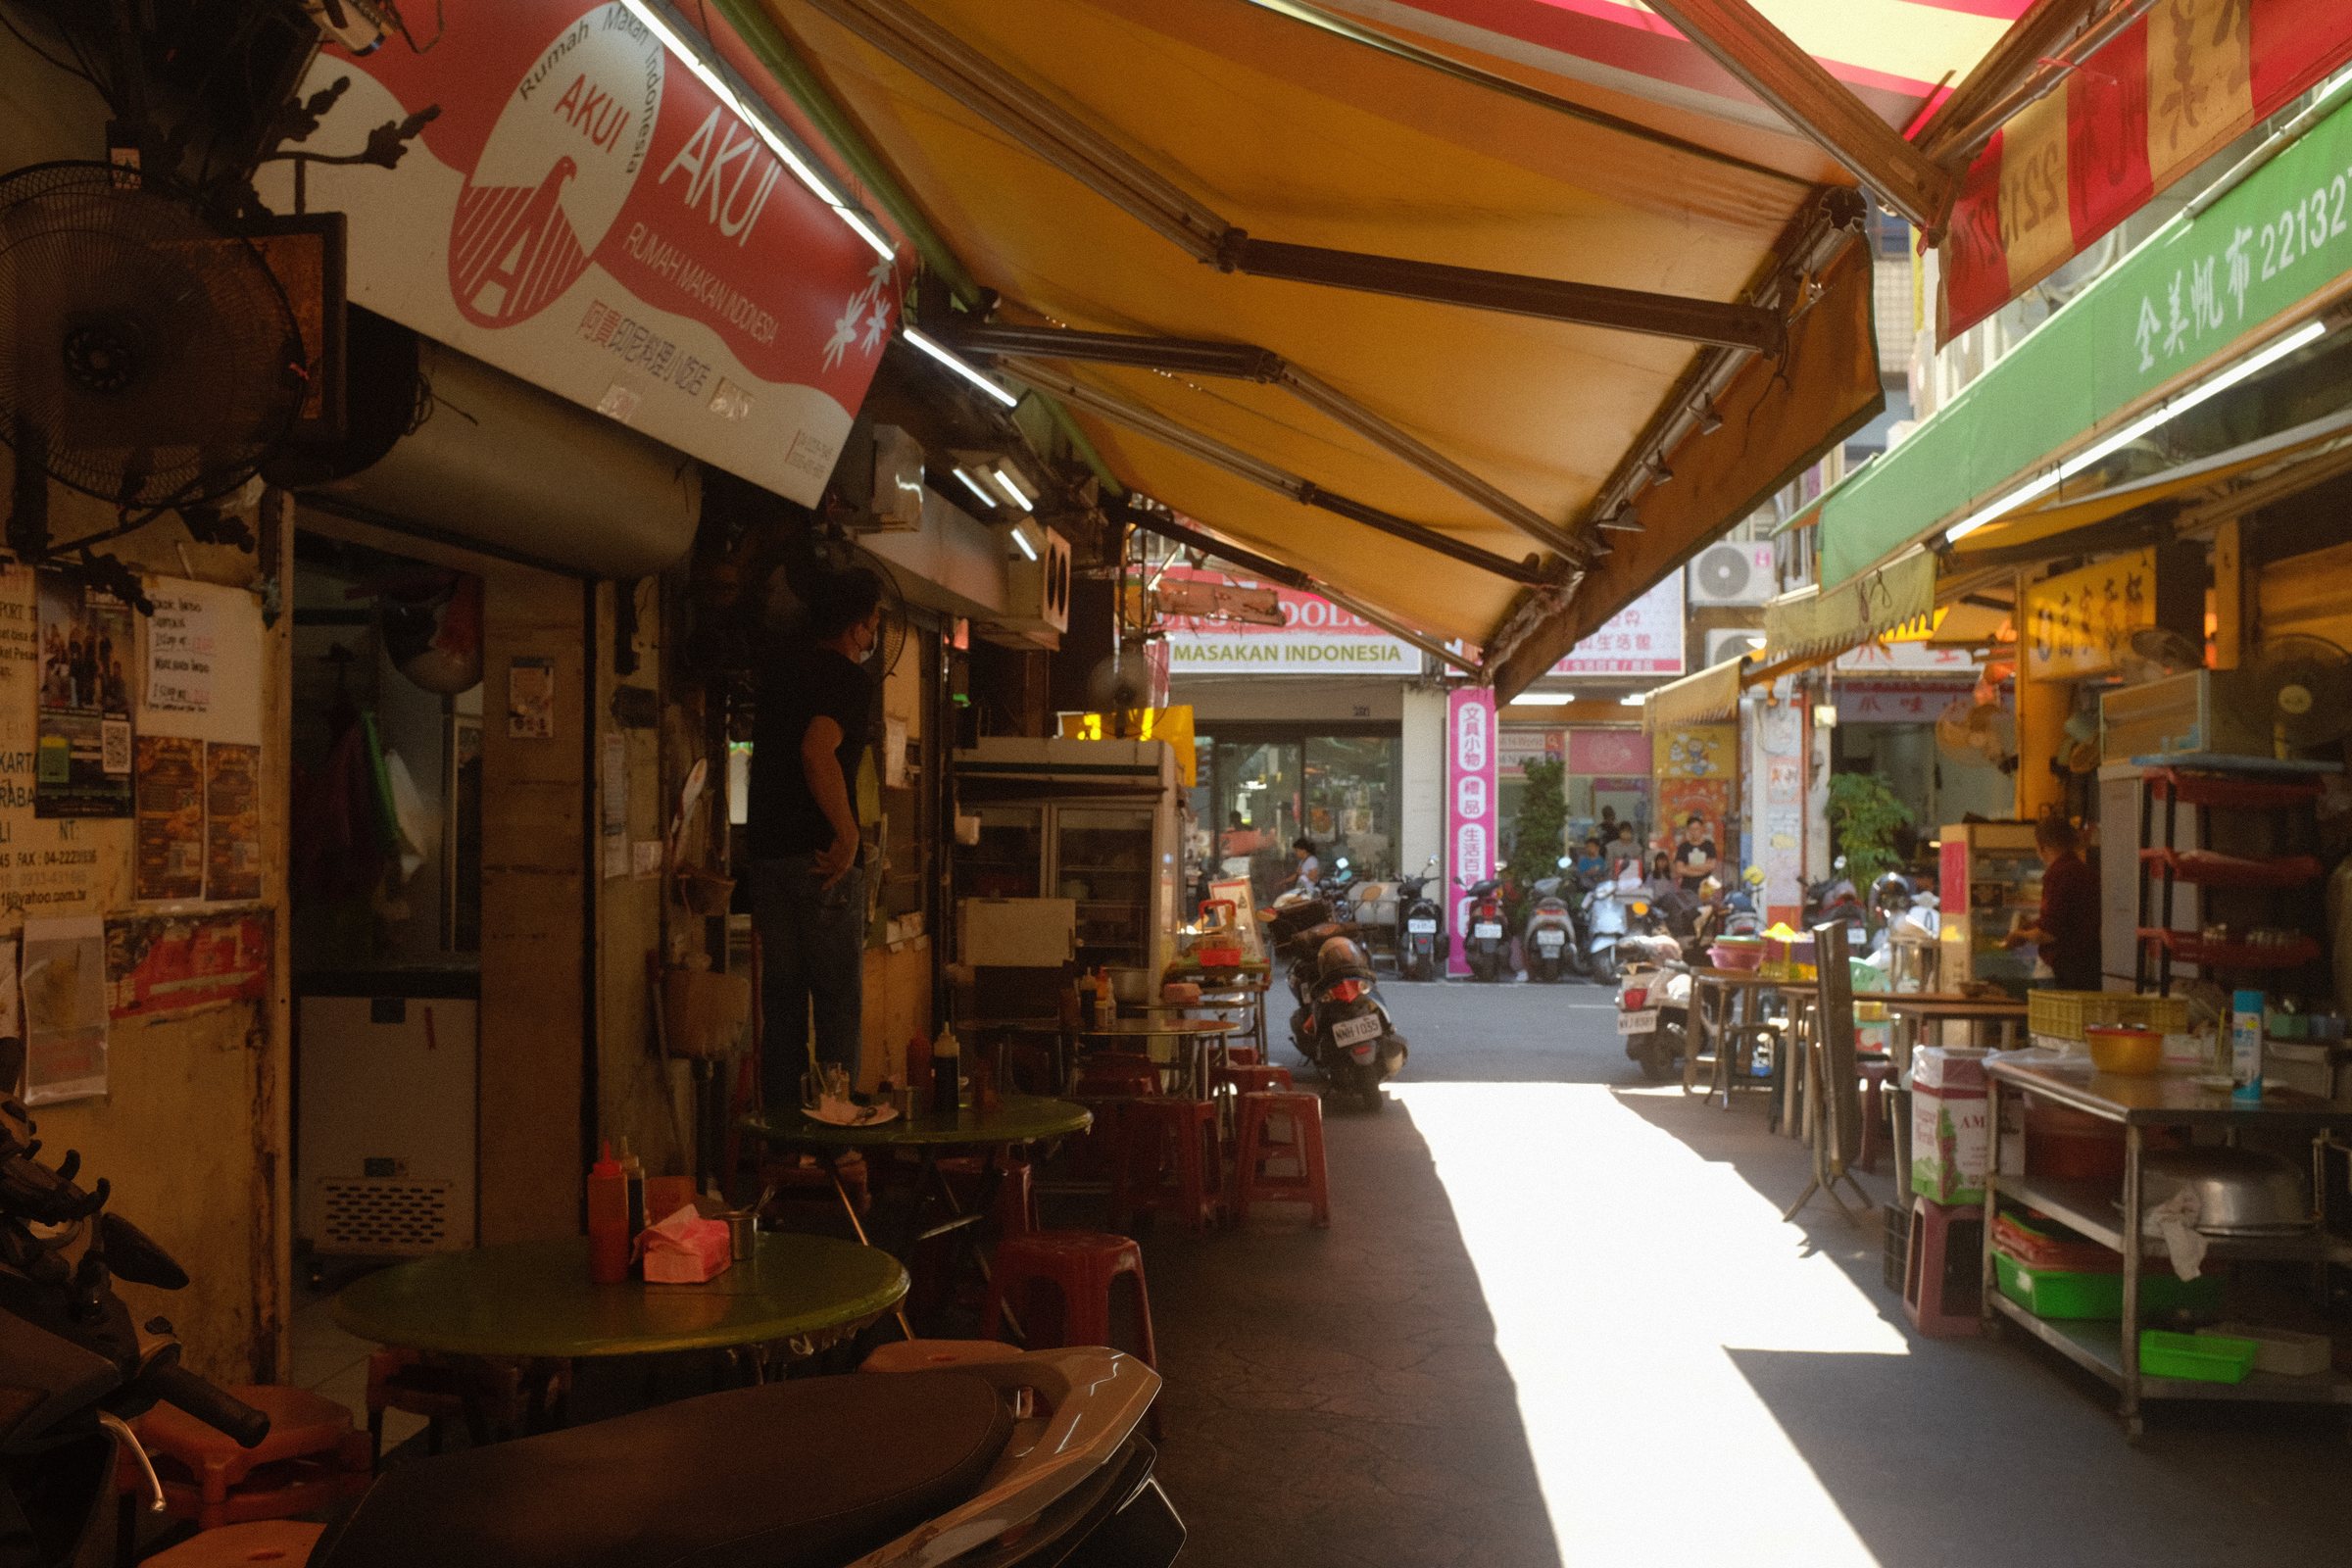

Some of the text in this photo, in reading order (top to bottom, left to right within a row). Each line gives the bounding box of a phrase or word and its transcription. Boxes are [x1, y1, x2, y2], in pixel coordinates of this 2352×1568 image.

[518, 6, 663, 174] Rumah Makan Indonesia
[553, 73, 631, 154] AKUI
[659, 105, 782, 247] AKUI
[2260, 167, 2352, 282] 22132
[622, 221, 780, 347] RUMAH MAKAN INDONESIA
[1174, 644, 1402, 662] MASAKAN INDONESIA
[1463, 706, 1482, 767] 文具小物
